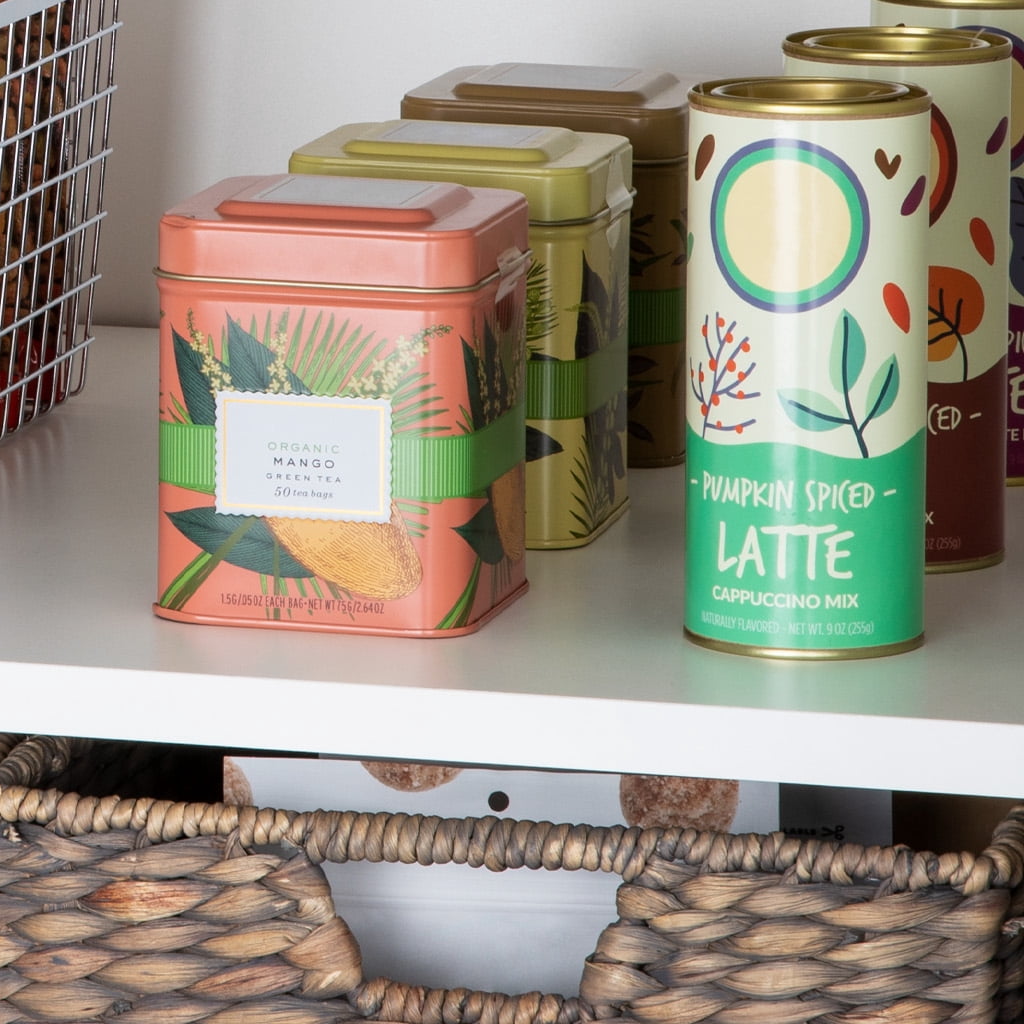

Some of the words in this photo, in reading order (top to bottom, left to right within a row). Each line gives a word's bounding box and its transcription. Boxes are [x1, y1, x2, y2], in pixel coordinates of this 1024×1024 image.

[267, 442, 340, 454] ORGANIC
[273, 457, 335, 469] MANGO
[266, 473, 310, 481] GREEN
[274, 486, 291, 497] 50
[292, 489, 308, 497] tea
[311, 489, 334, 499] bags
[703, 470, 794, 512] PUMPKIN
[805, 479, 875, 514] SPICED
[717, 521, 855, 580] LATTE
[265, 596, 285, 608] EACH
[712, 585, 821, 609] CAPPUCCINO
[825, 593, 859, 609] MIX
[701, 610, 736, 629] NATURALLY
[737, 617, 780, 634] FLAVORED
[789, 622, 806, 635] NET
[826, 623, 833, 635] 9
[834, 623, 846, 635] OZ
